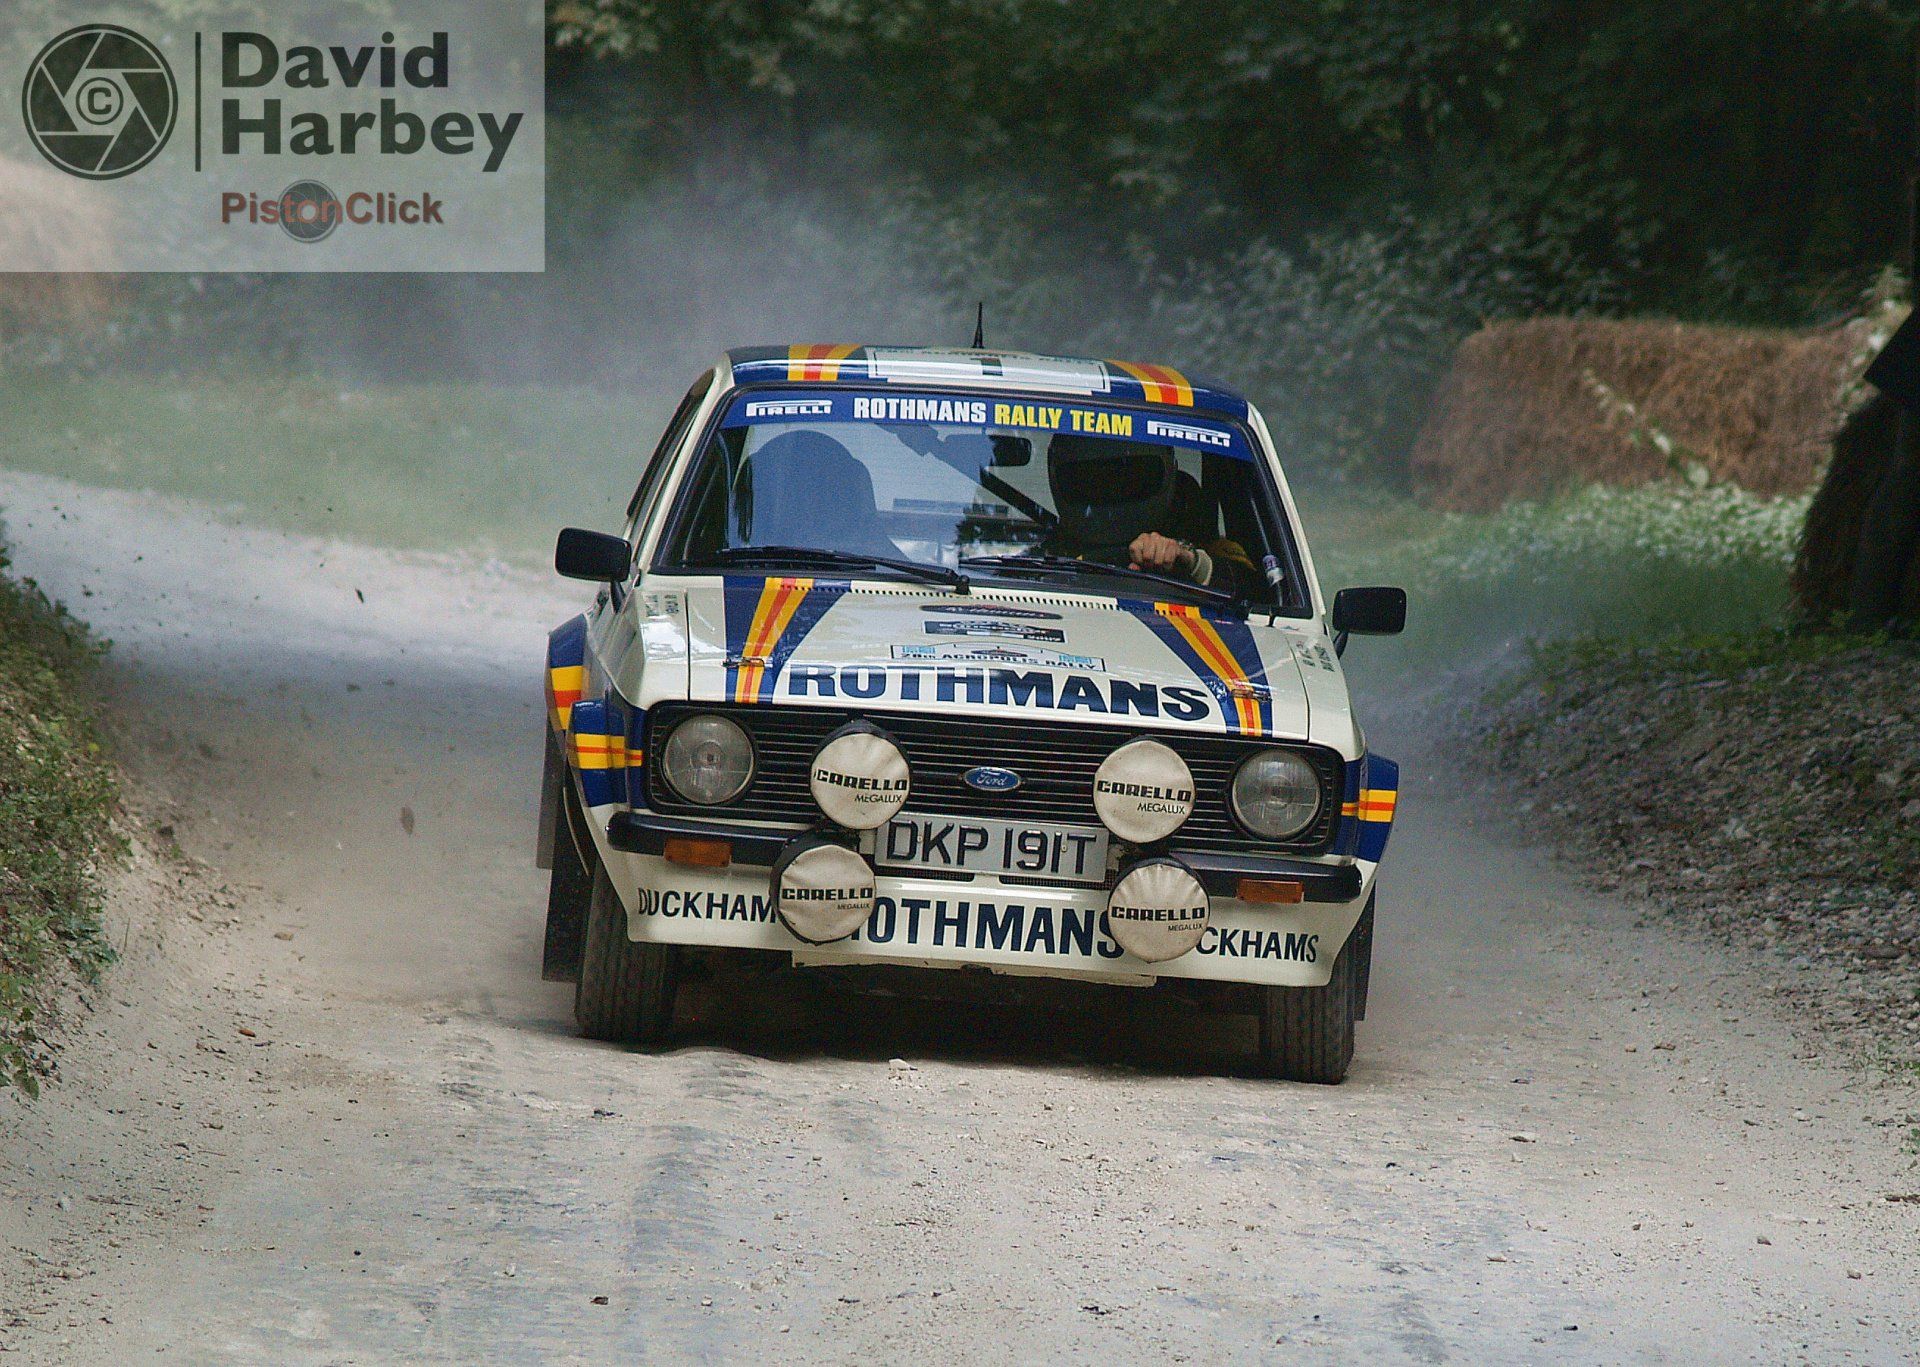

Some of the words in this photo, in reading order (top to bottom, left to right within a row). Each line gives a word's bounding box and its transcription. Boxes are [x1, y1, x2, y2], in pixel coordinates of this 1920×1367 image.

[745, 399, 833, 417] PIRELLI
[853, 396, 987, 423] ROTHMANS
[994, 403, 1063, 430] RALLY
[1069, 409, 1133, 437] TEAM
[1146, 420, 1231, 448] PIRELLI
[1045, 659, 1096, 669] RALLY
[787, 663, 1210, 722] ROTHMANS
[816, 769, 908, 791] CARELLO
[976, 770, 1008, 787] Ford
[854, 793, 902, 804] MEGALUX
[1096, 780, 1192, 802] CARELLO
[1136, 802, 1185, 815] MEGALUX
[886, 819, 989, 866] DKP
[1003, 827, 1097, 875] 191T
[781, 887, 874, 901] CARELLO
[637, 887, 777, 924] DUCKHAM
[1111, 906, 1206, 922] CARELLO
[850, 896, 1125, 959] OTHMANS
[1167, 922, 1204, 932] MEGALUX
[1194, 926, 1319, 963] CKHAMS
